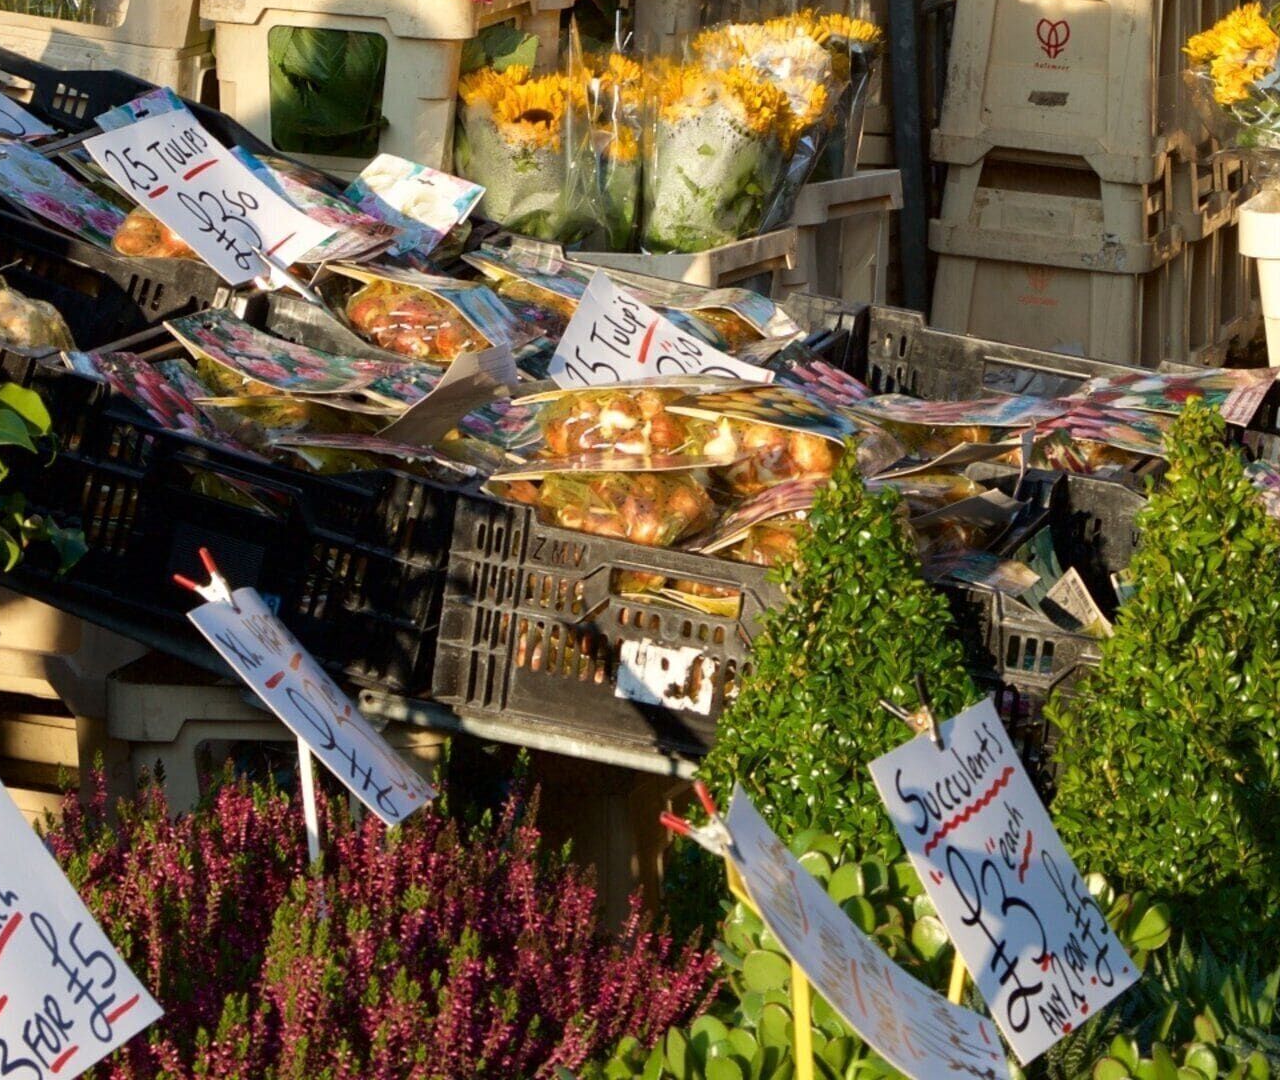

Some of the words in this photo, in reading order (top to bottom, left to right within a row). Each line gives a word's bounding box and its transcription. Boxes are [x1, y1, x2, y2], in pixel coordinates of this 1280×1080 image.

[105, 148, 158, 191] 25
[996, 800, 1026, 875] each
[29, 911, 117, 1043] £5
[23, 994, 75, 1070] FOR
